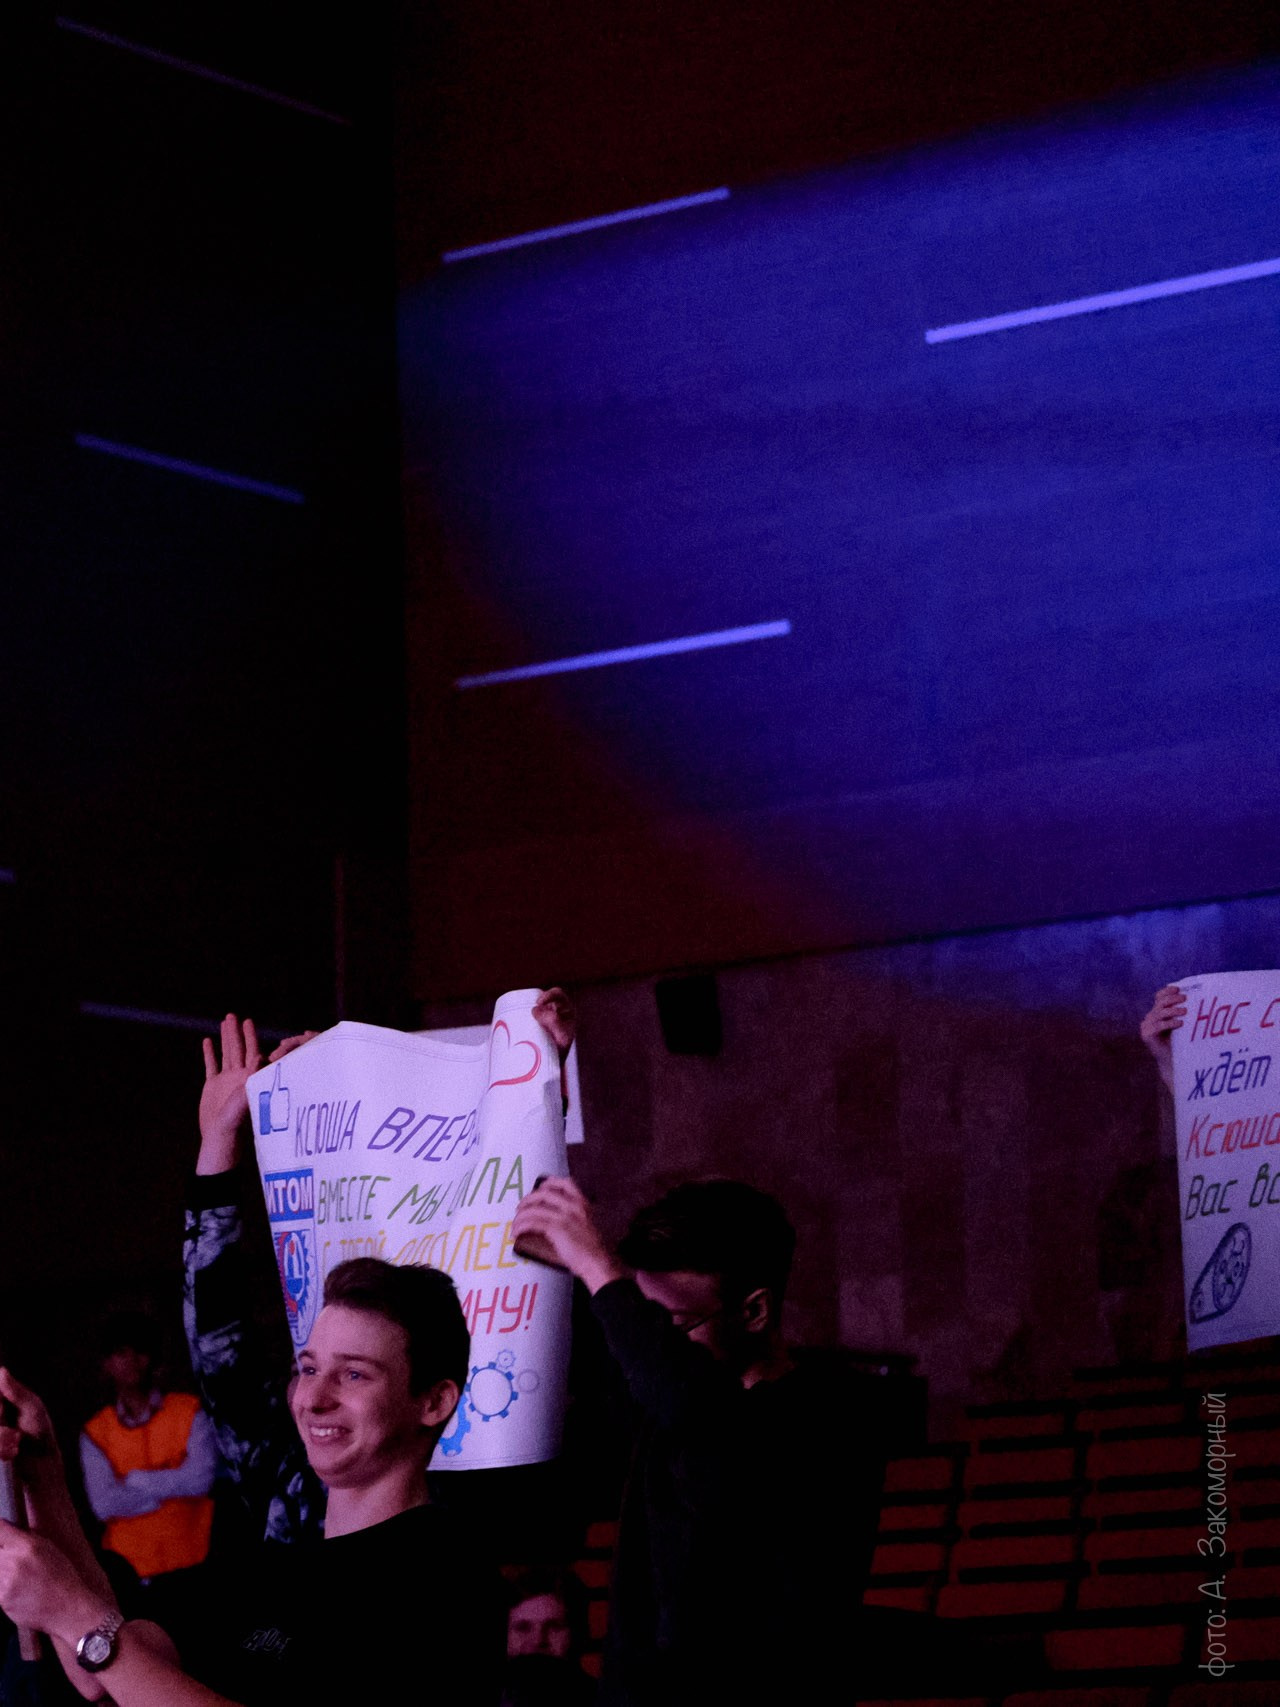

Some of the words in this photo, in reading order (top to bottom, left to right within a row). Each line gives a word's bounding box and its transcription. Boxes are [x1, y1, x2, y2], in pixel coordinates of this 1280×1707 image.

[294, 1100, 362, 1158] КСЮША
[317, 1175, 391, 1225] ВМЕСТЕ
[387, 1181, 453, 1225] МЫ
[1185, 1174, 1238, 1220] Вас
